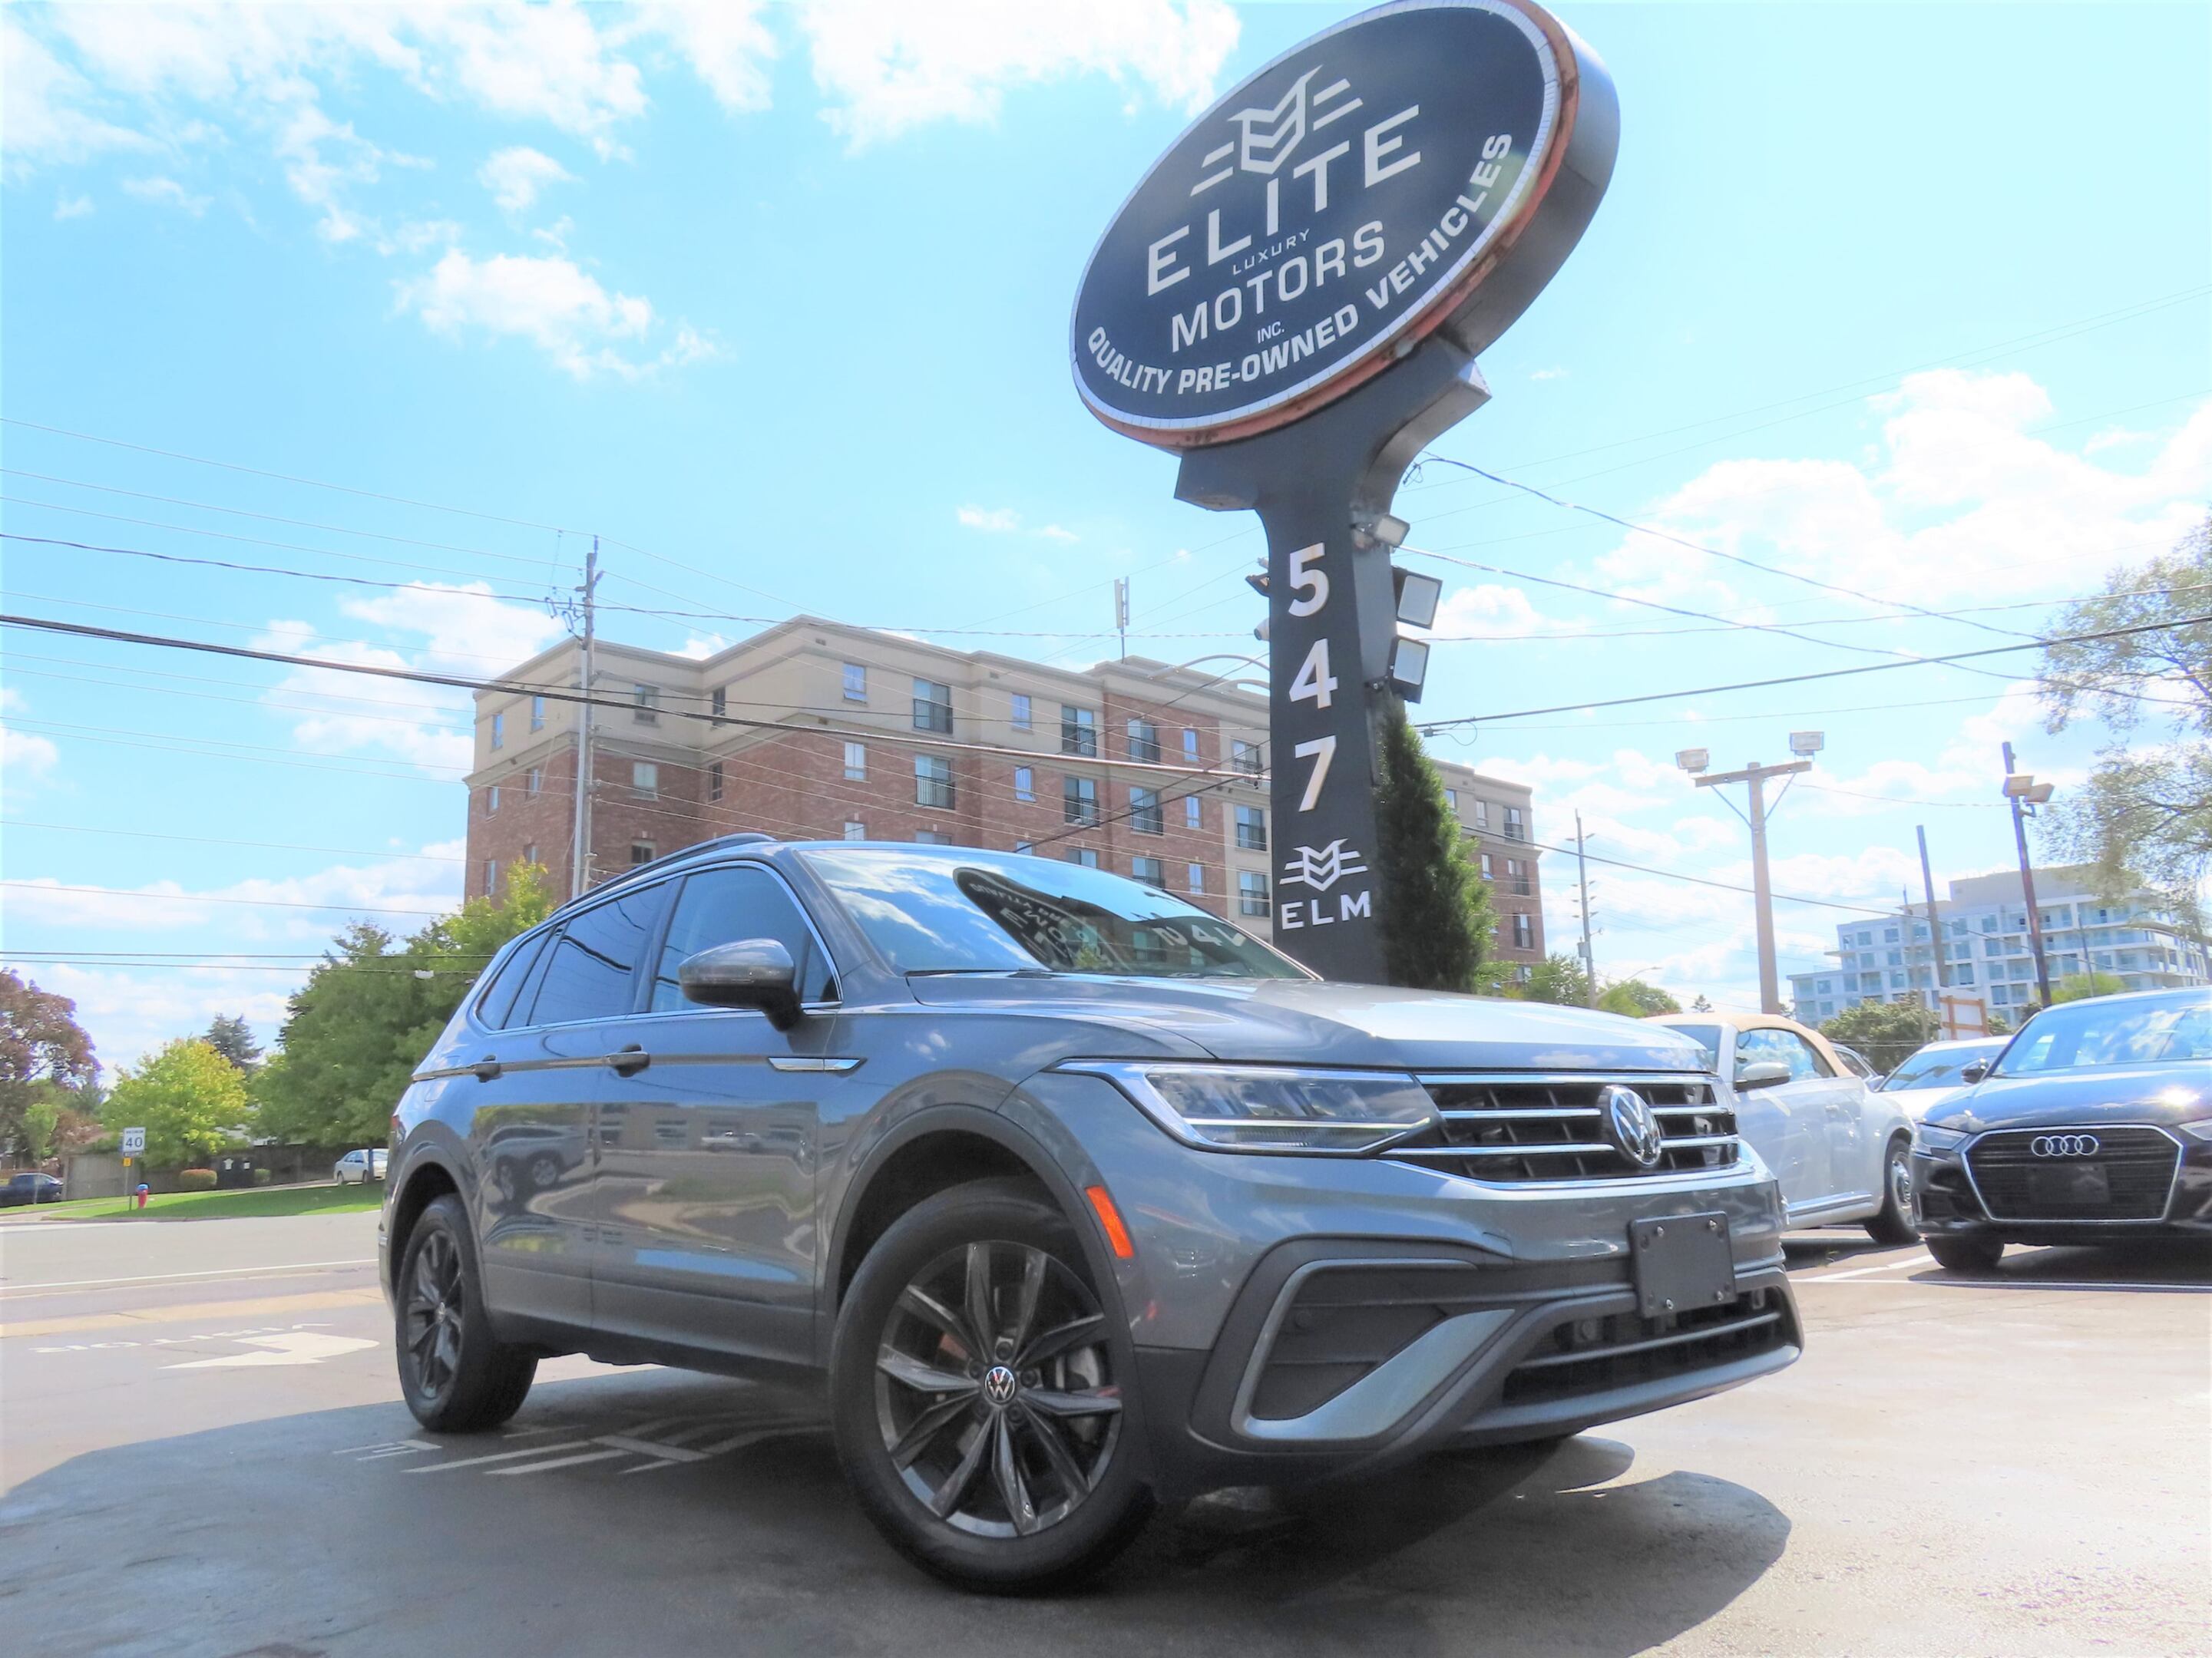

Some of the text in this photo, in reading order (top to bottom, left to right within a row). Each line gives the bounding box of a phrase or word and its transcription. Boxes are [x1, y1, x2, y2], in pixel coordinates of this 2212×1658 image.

[1147, 104, 1420, 296] ELITE
[1087, 133, 1513, 395] QUALITY PRE-OWNED VEHICLES
[1233, 228, 1310, 275] LUXURY
[1172, 220, 1384, 353] MOTORS
[1257, 321, 1285, 344] INC.
[1281, 890, 1371, 930] ELM
[125, 1137, 143, 1148] 40
